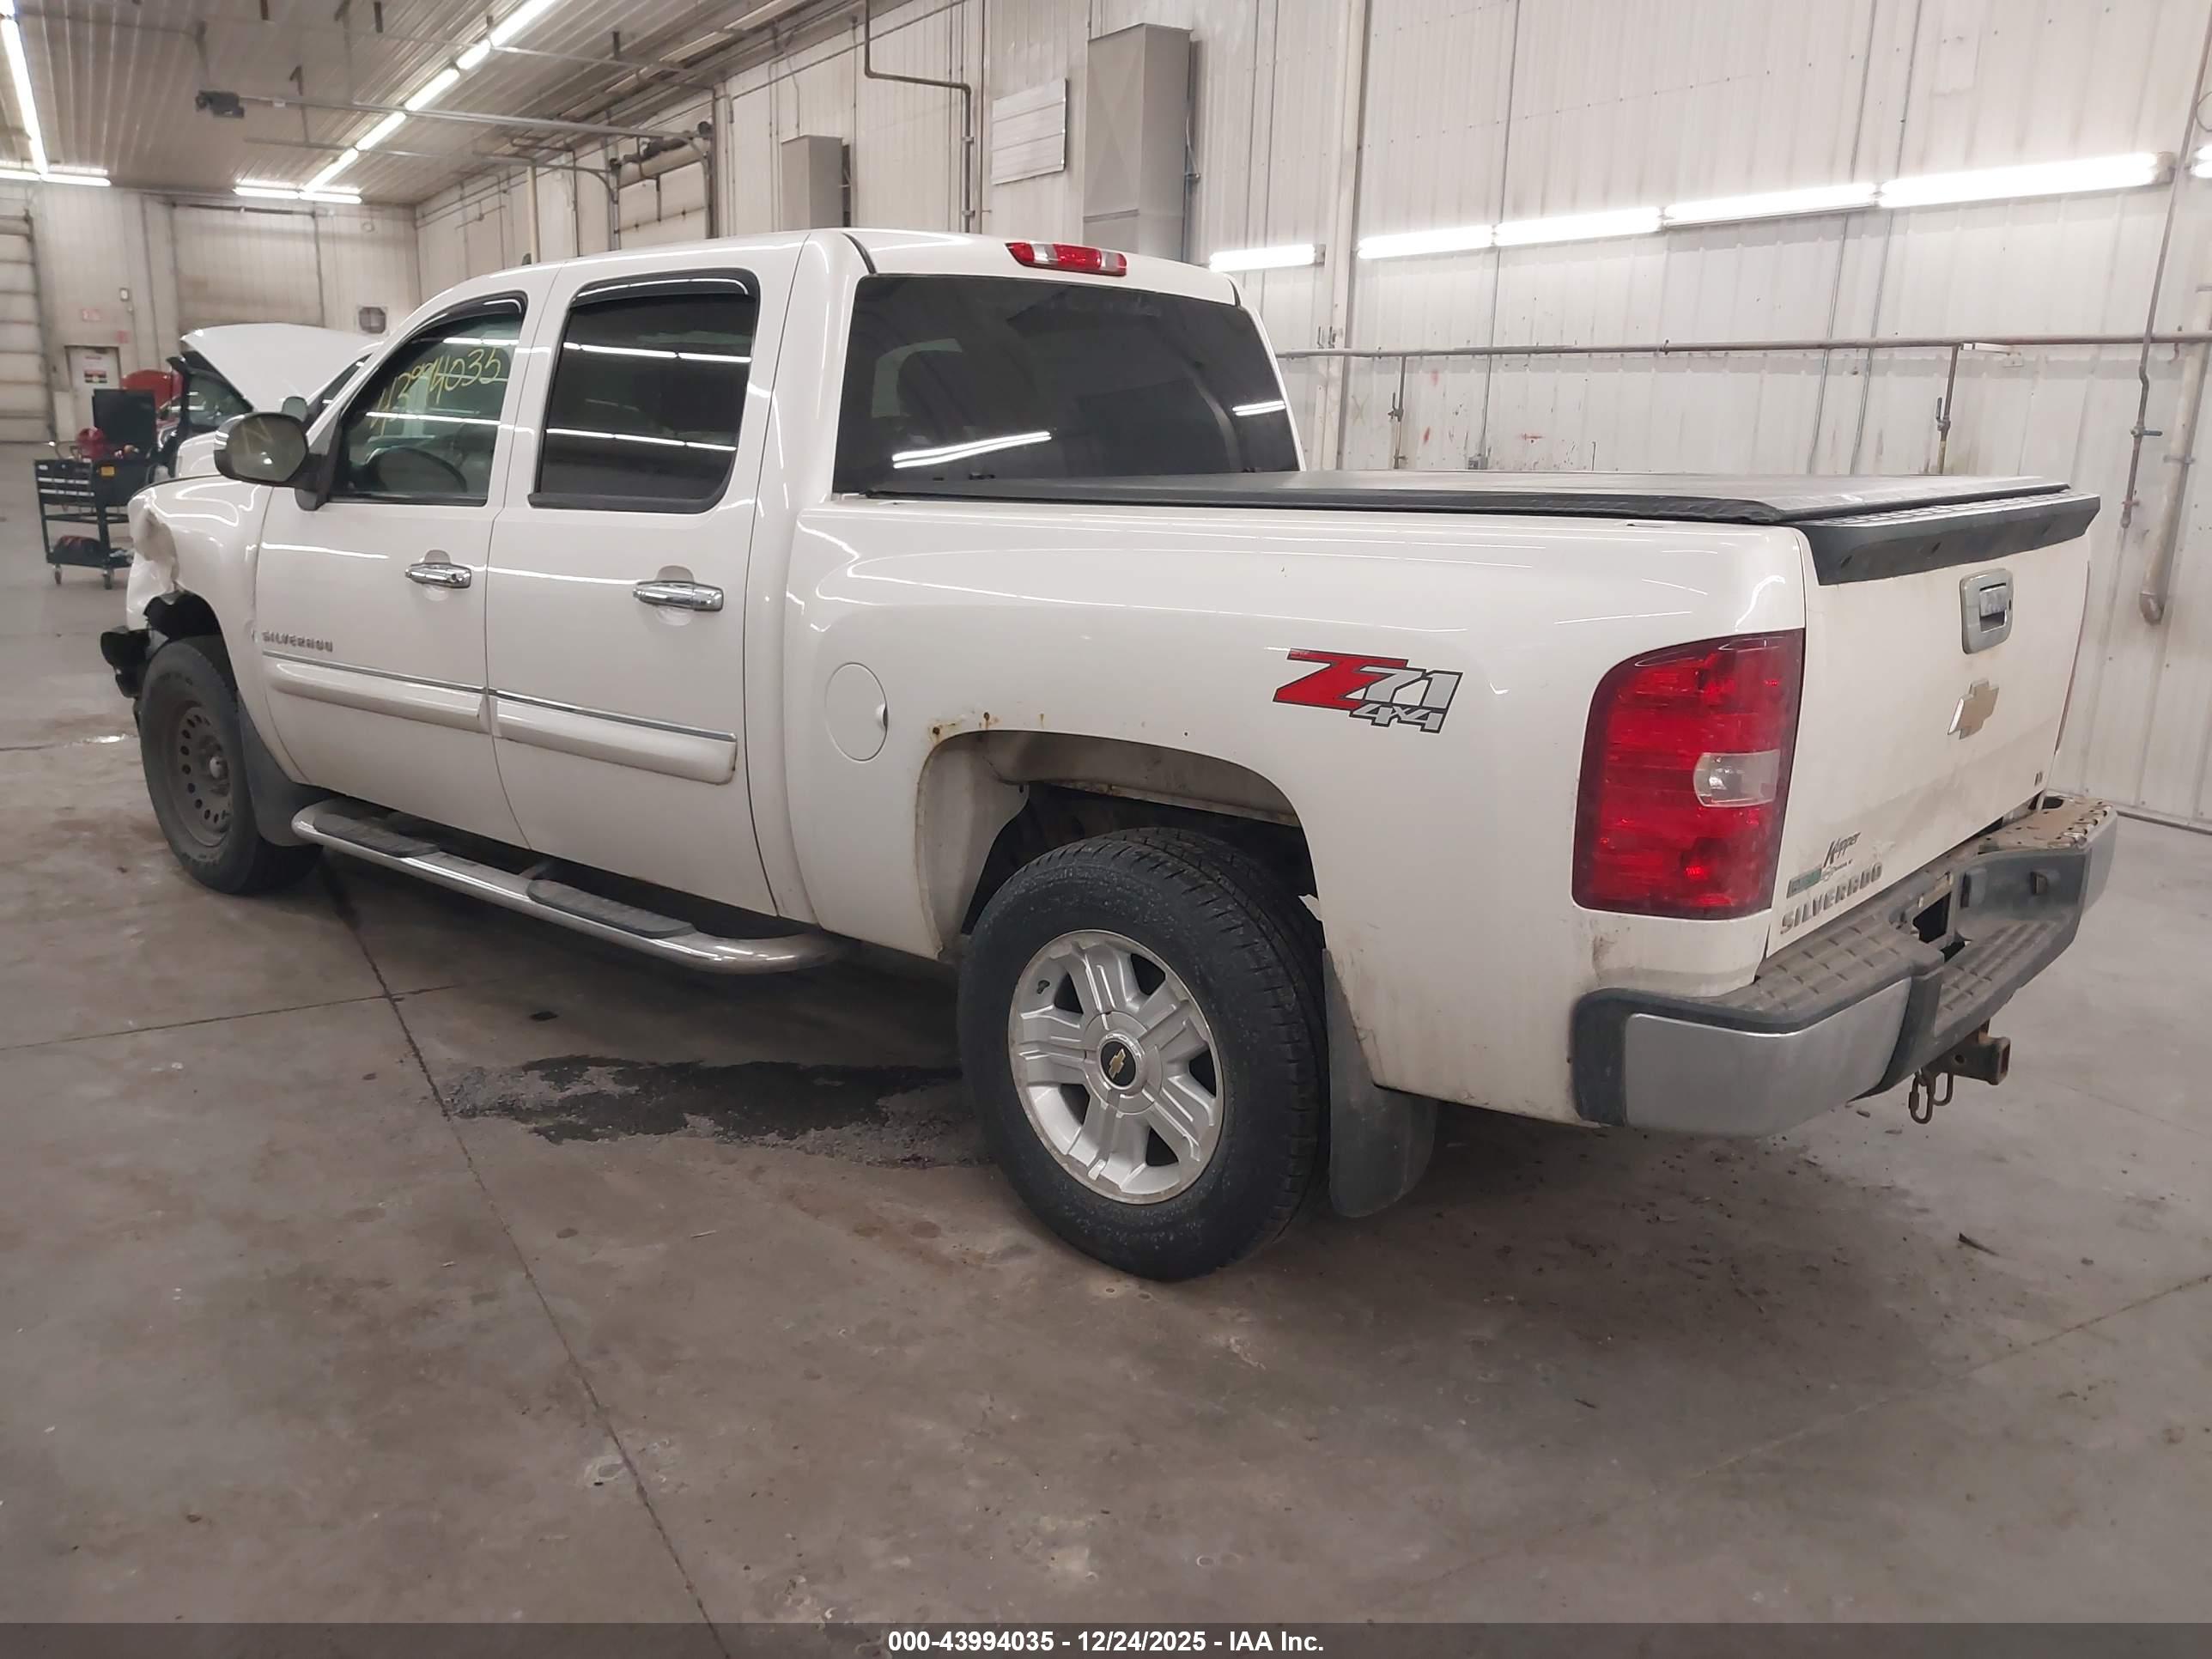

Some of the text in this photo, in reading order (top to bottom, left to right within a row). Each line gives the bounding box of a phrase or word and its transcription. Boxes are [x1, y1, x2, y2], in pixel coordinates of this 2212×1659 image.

[262, 629, 333, 653] SILVERADO
[1273, 647, 1463, 713] Z71
[1780, 861, 1883, 934] SILVERADO
